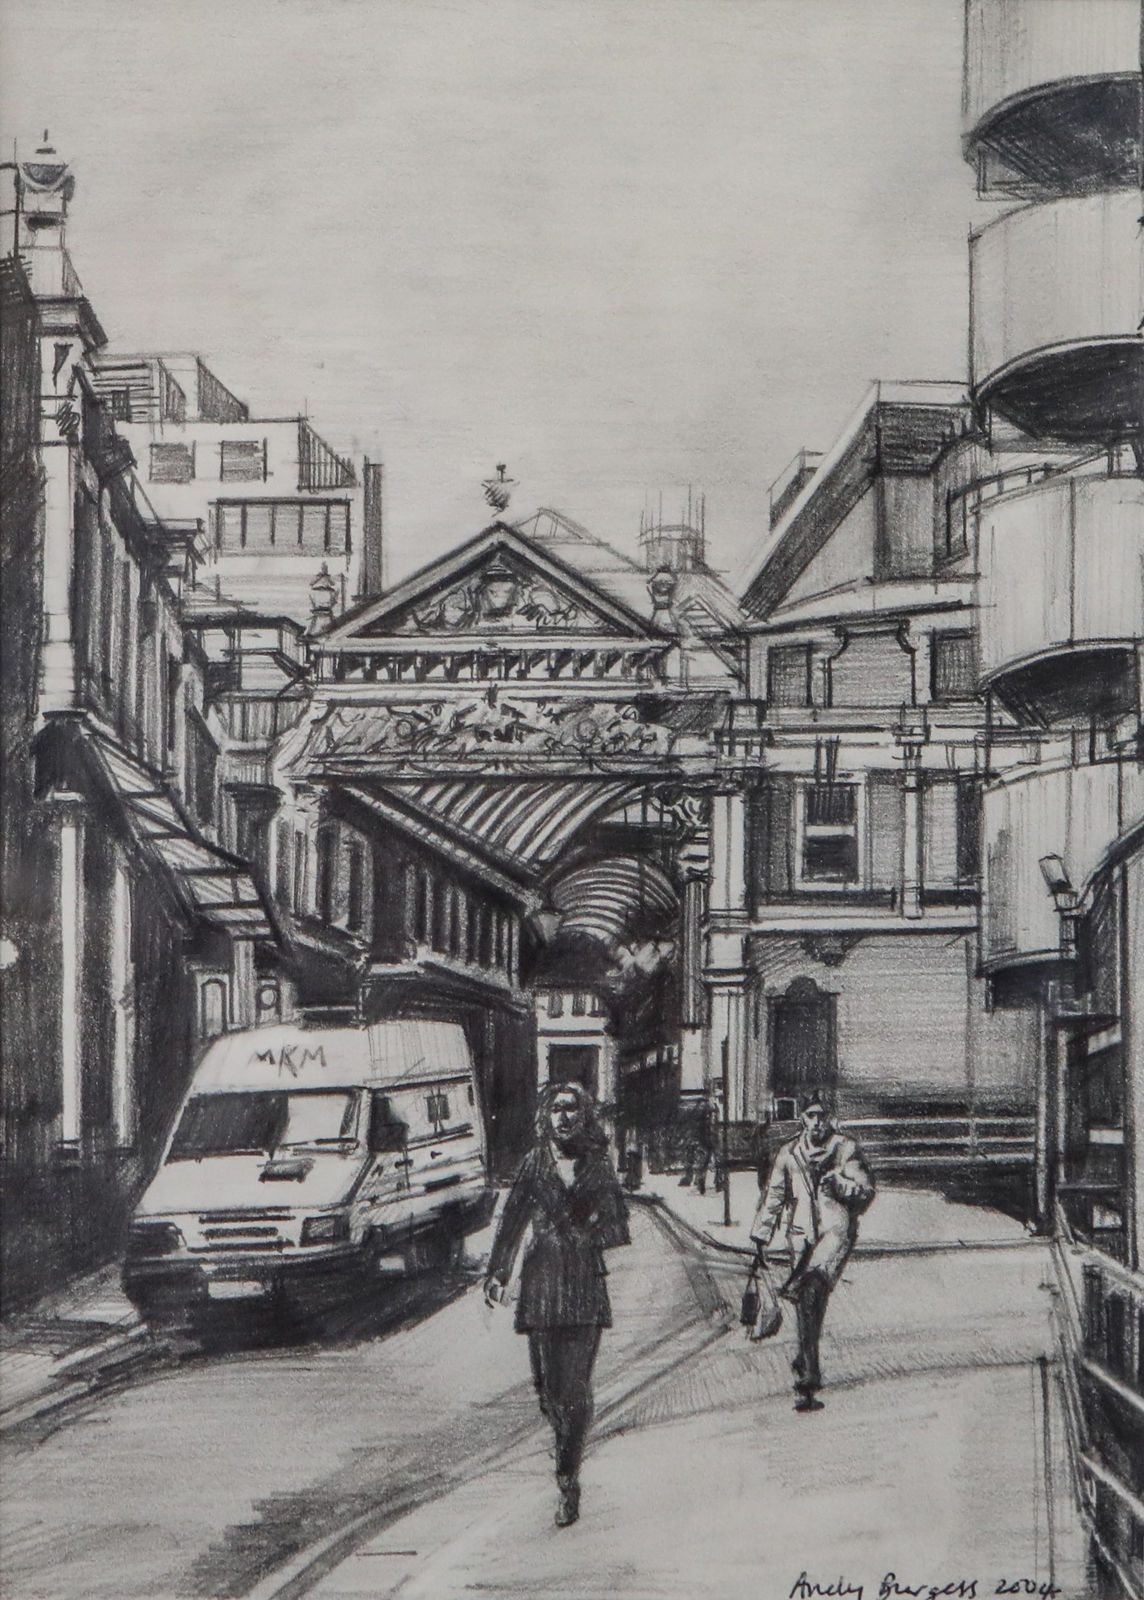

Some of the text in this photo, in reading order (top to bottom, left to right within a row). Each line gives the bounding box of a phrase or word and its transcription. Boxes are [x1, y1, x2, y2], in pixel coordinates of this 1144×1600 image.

[247, 1044, 327, 1078] MKM
[789, 1571, 1062, 1600] Andy Burgess 2004
